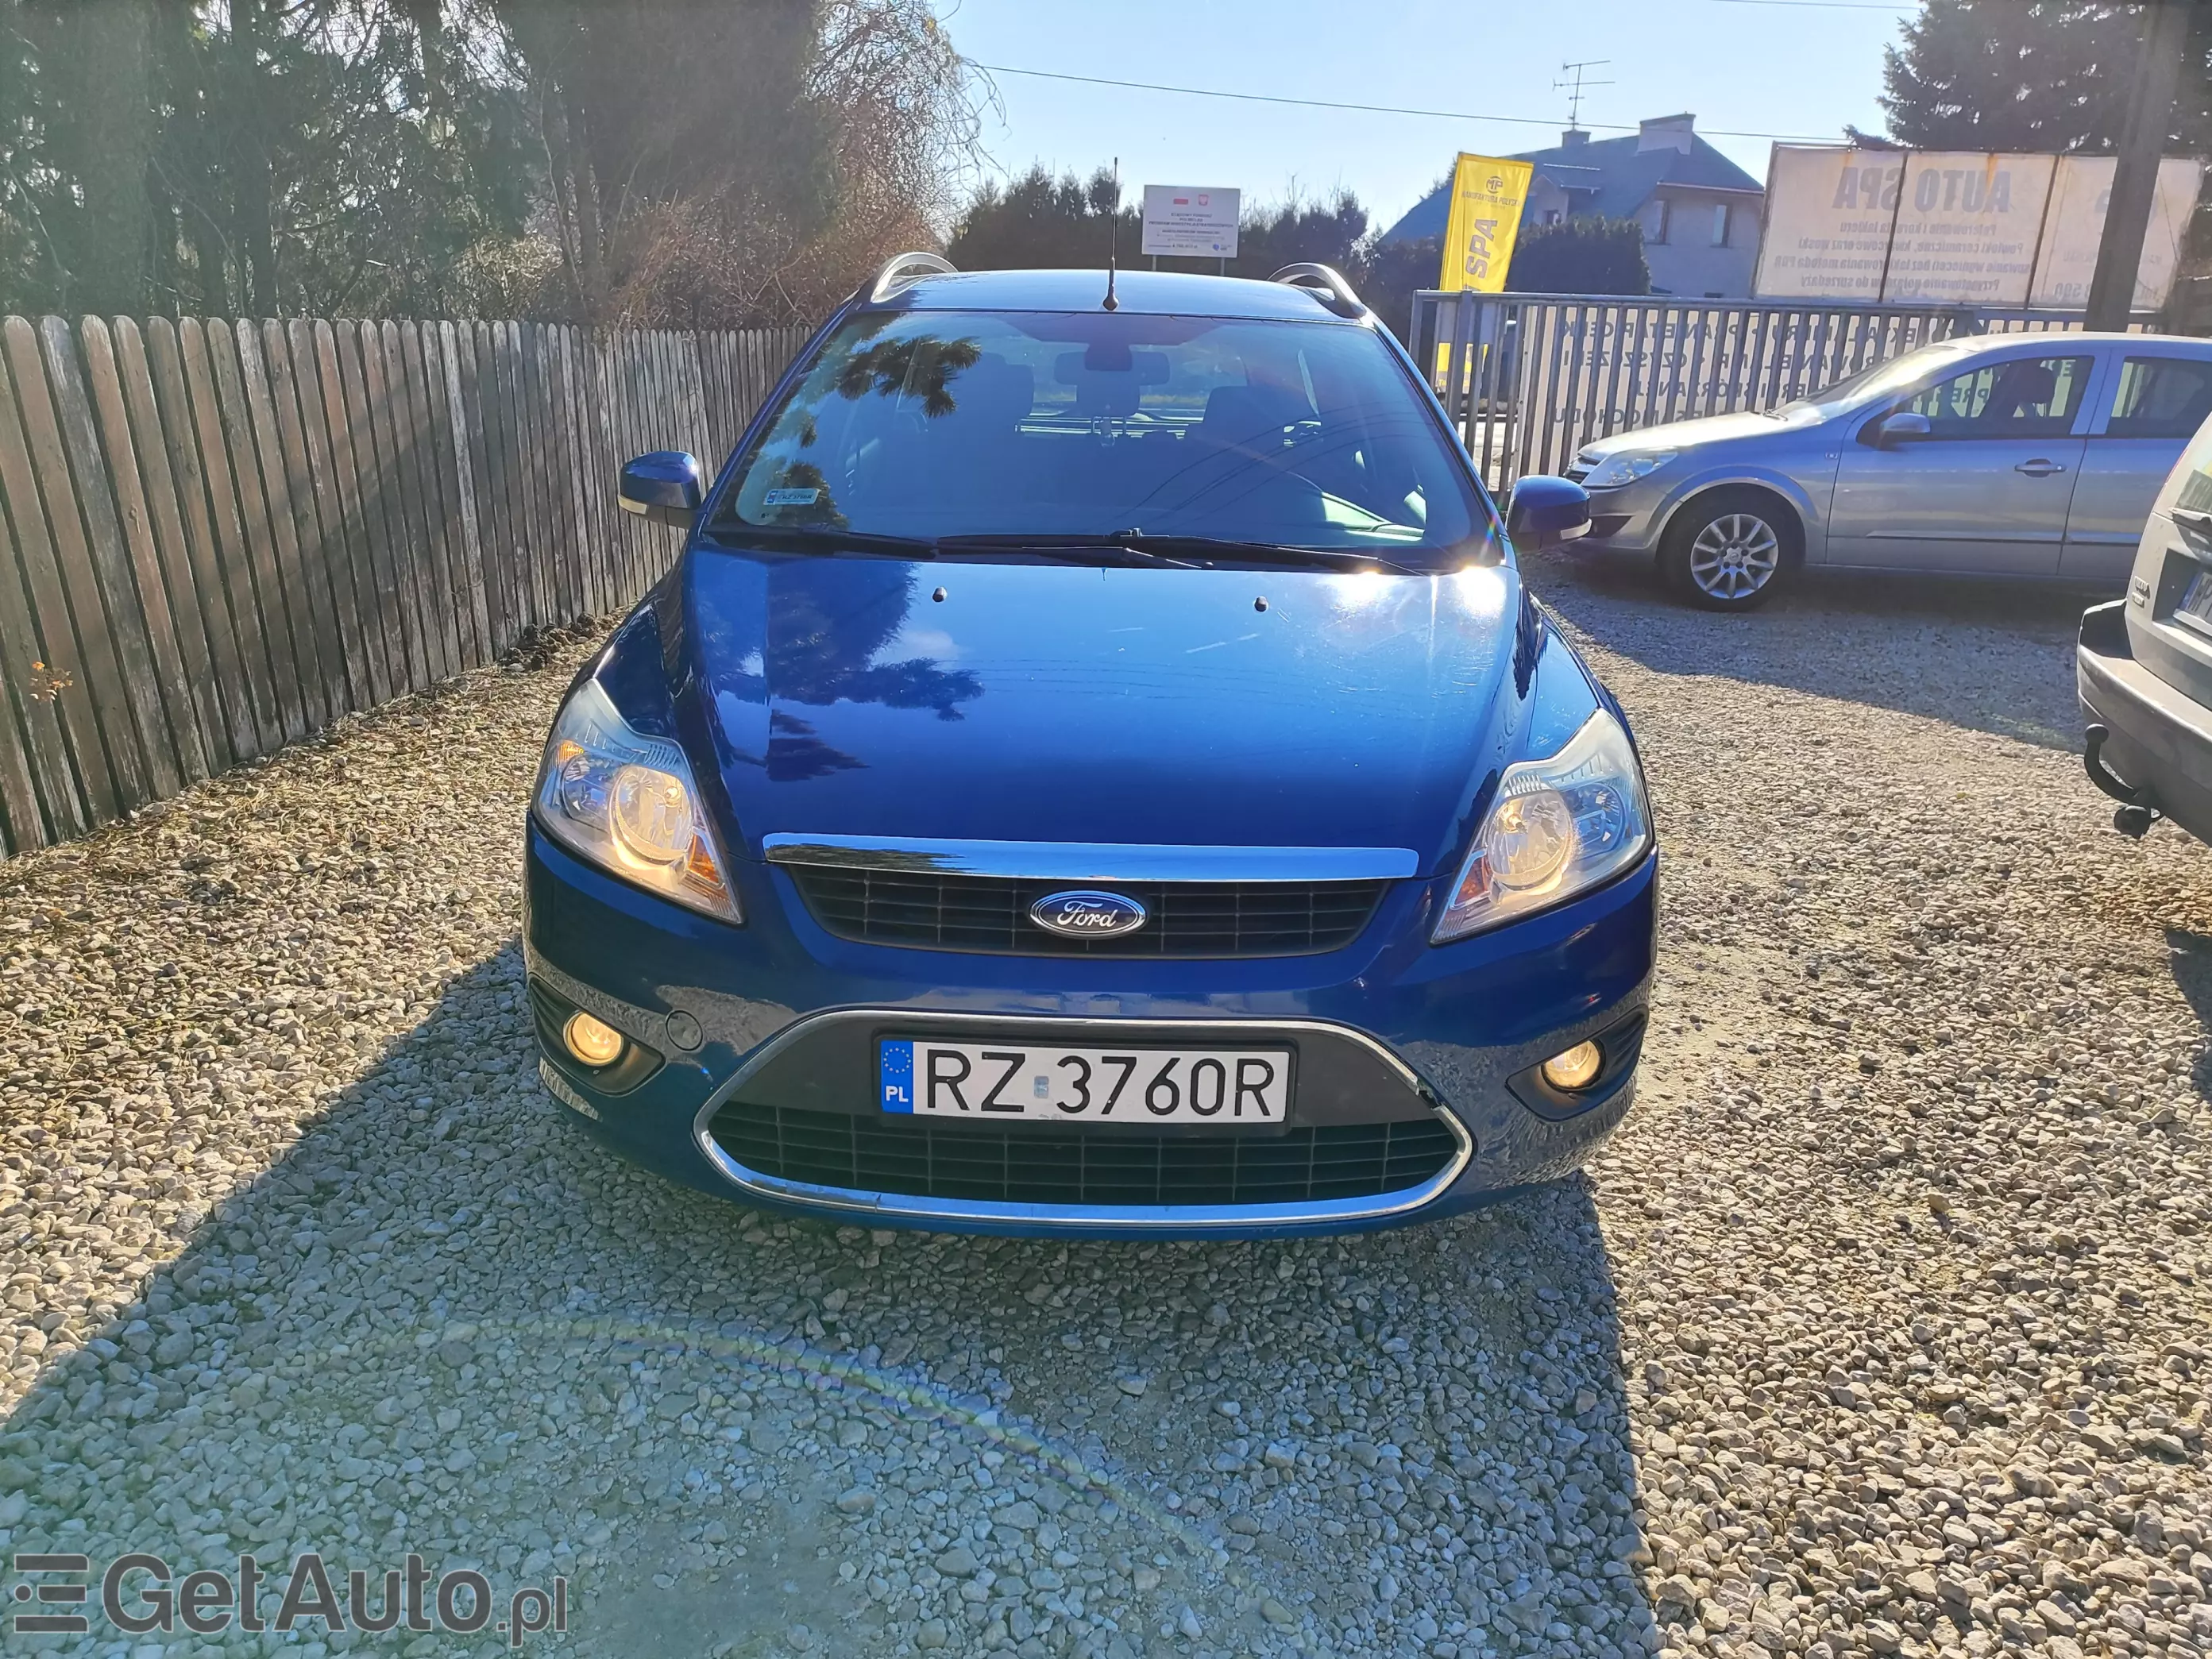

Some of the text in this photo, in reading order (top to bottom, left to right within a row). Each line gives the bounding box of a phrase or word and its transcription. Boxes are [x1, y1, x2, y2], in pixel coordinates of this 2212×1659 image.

[1466, 218, 1497, 278] SPA
[1057, 900, 1118, 928] Ford
[885, 1085, 909, 1103] PL
[926, 1048, 1276, 1117] RZ 3760R
